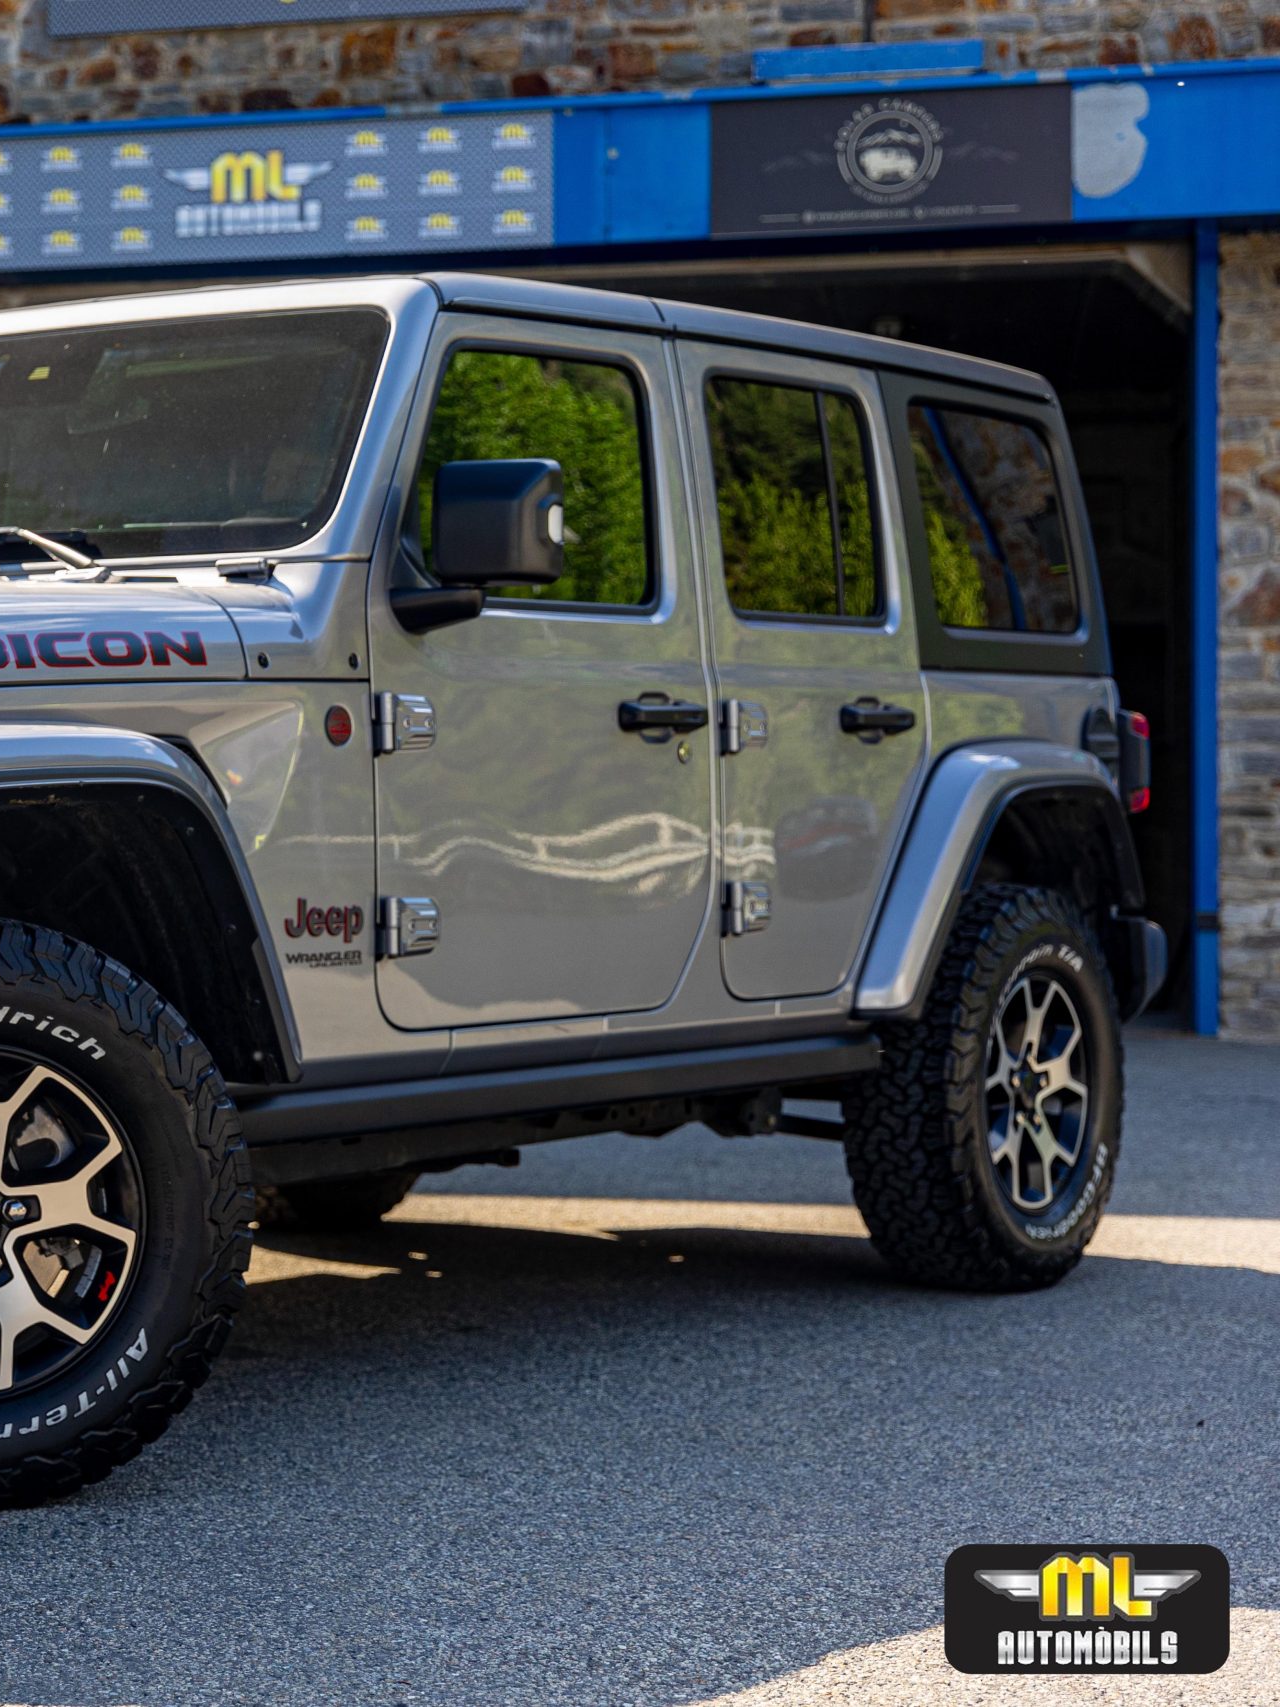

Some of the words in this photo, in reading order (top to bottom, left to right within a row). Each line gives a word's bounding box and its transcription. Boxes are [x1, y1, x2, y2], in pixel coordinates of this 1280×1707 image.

[210, 149, 301, 204] ML
[284, 897, 364, 944] Jeep
[285, 950, 362, 964] WRANGLER
